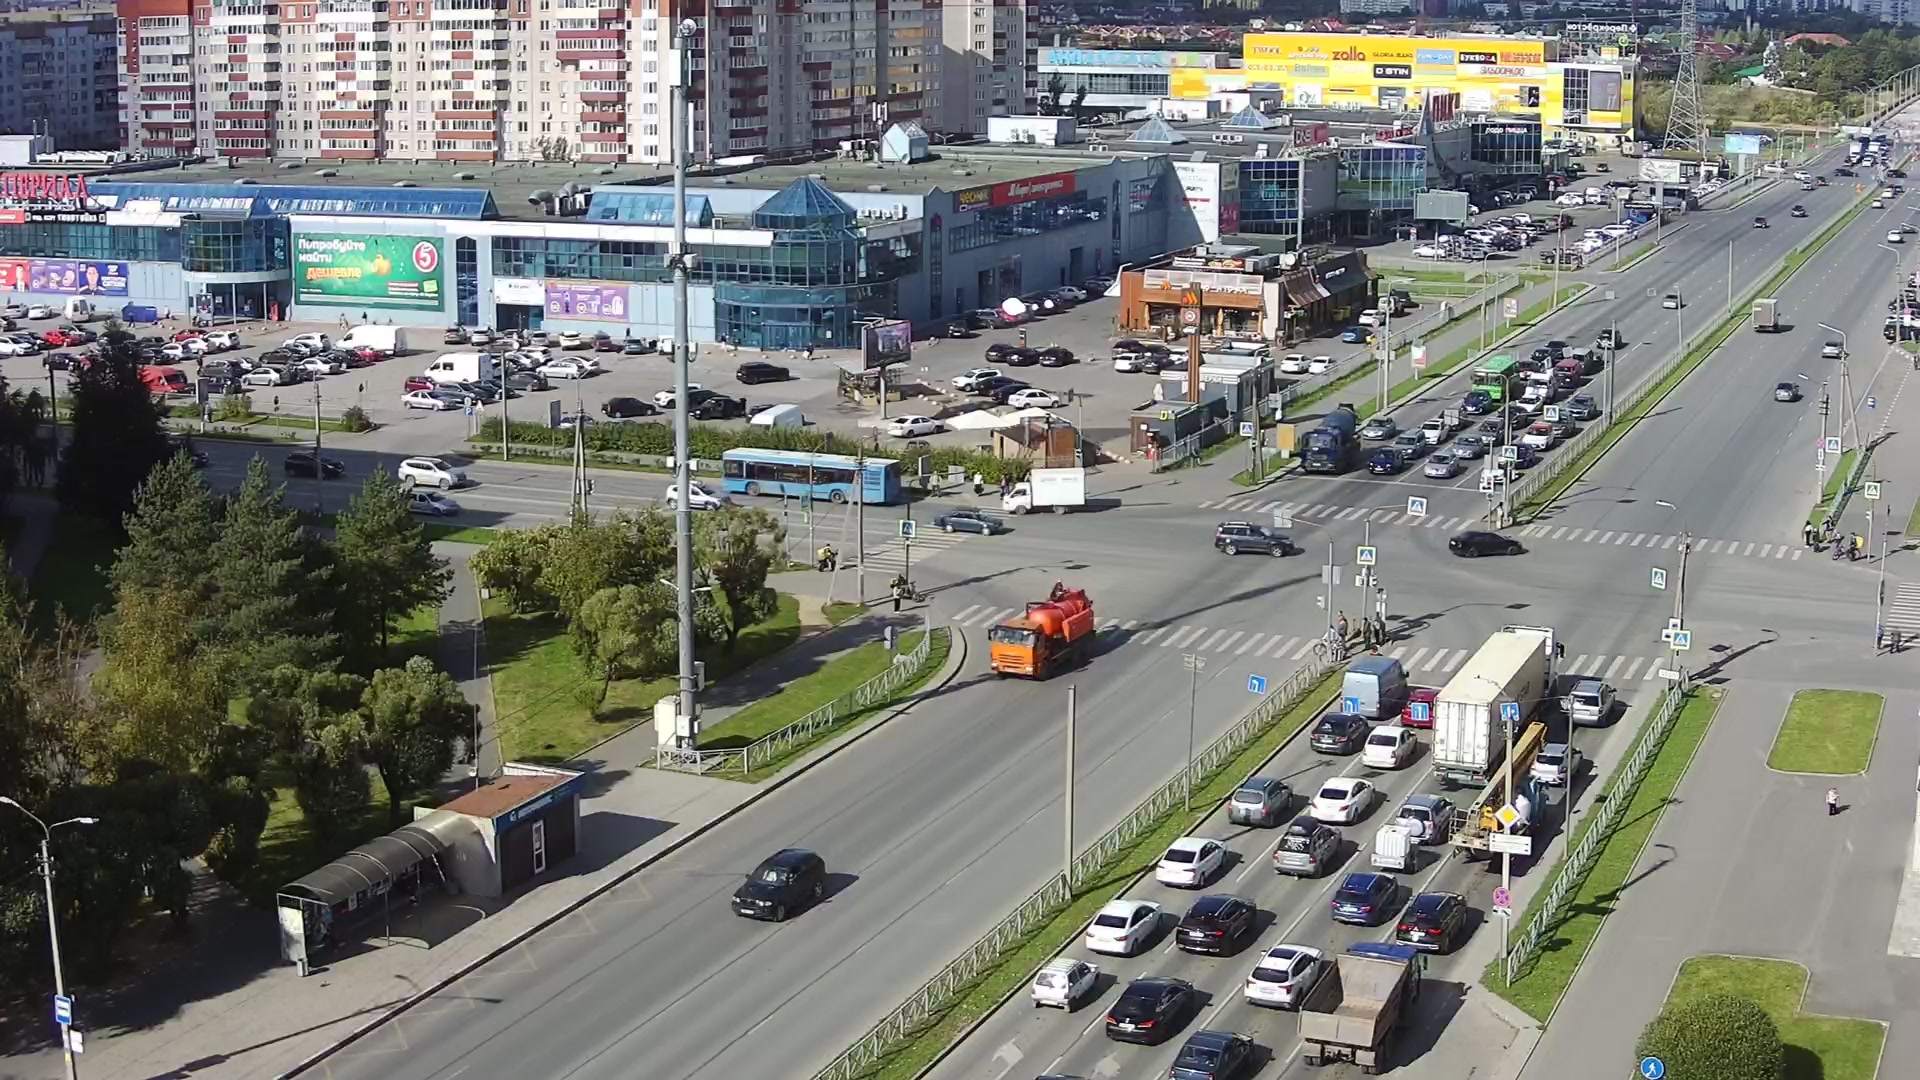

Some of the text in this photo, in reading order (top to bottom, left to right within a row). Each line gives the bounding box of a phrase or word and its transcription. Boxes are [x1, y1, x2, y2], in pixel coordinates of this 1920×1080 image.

[1332, 46, 1366, 61] zolla
[298, 238, 366, 253] Попробуйте
[298, 252, 333, 263] найти
[419, 245, 432, 266] 5
[306, 267, 362, 280] дешевле
